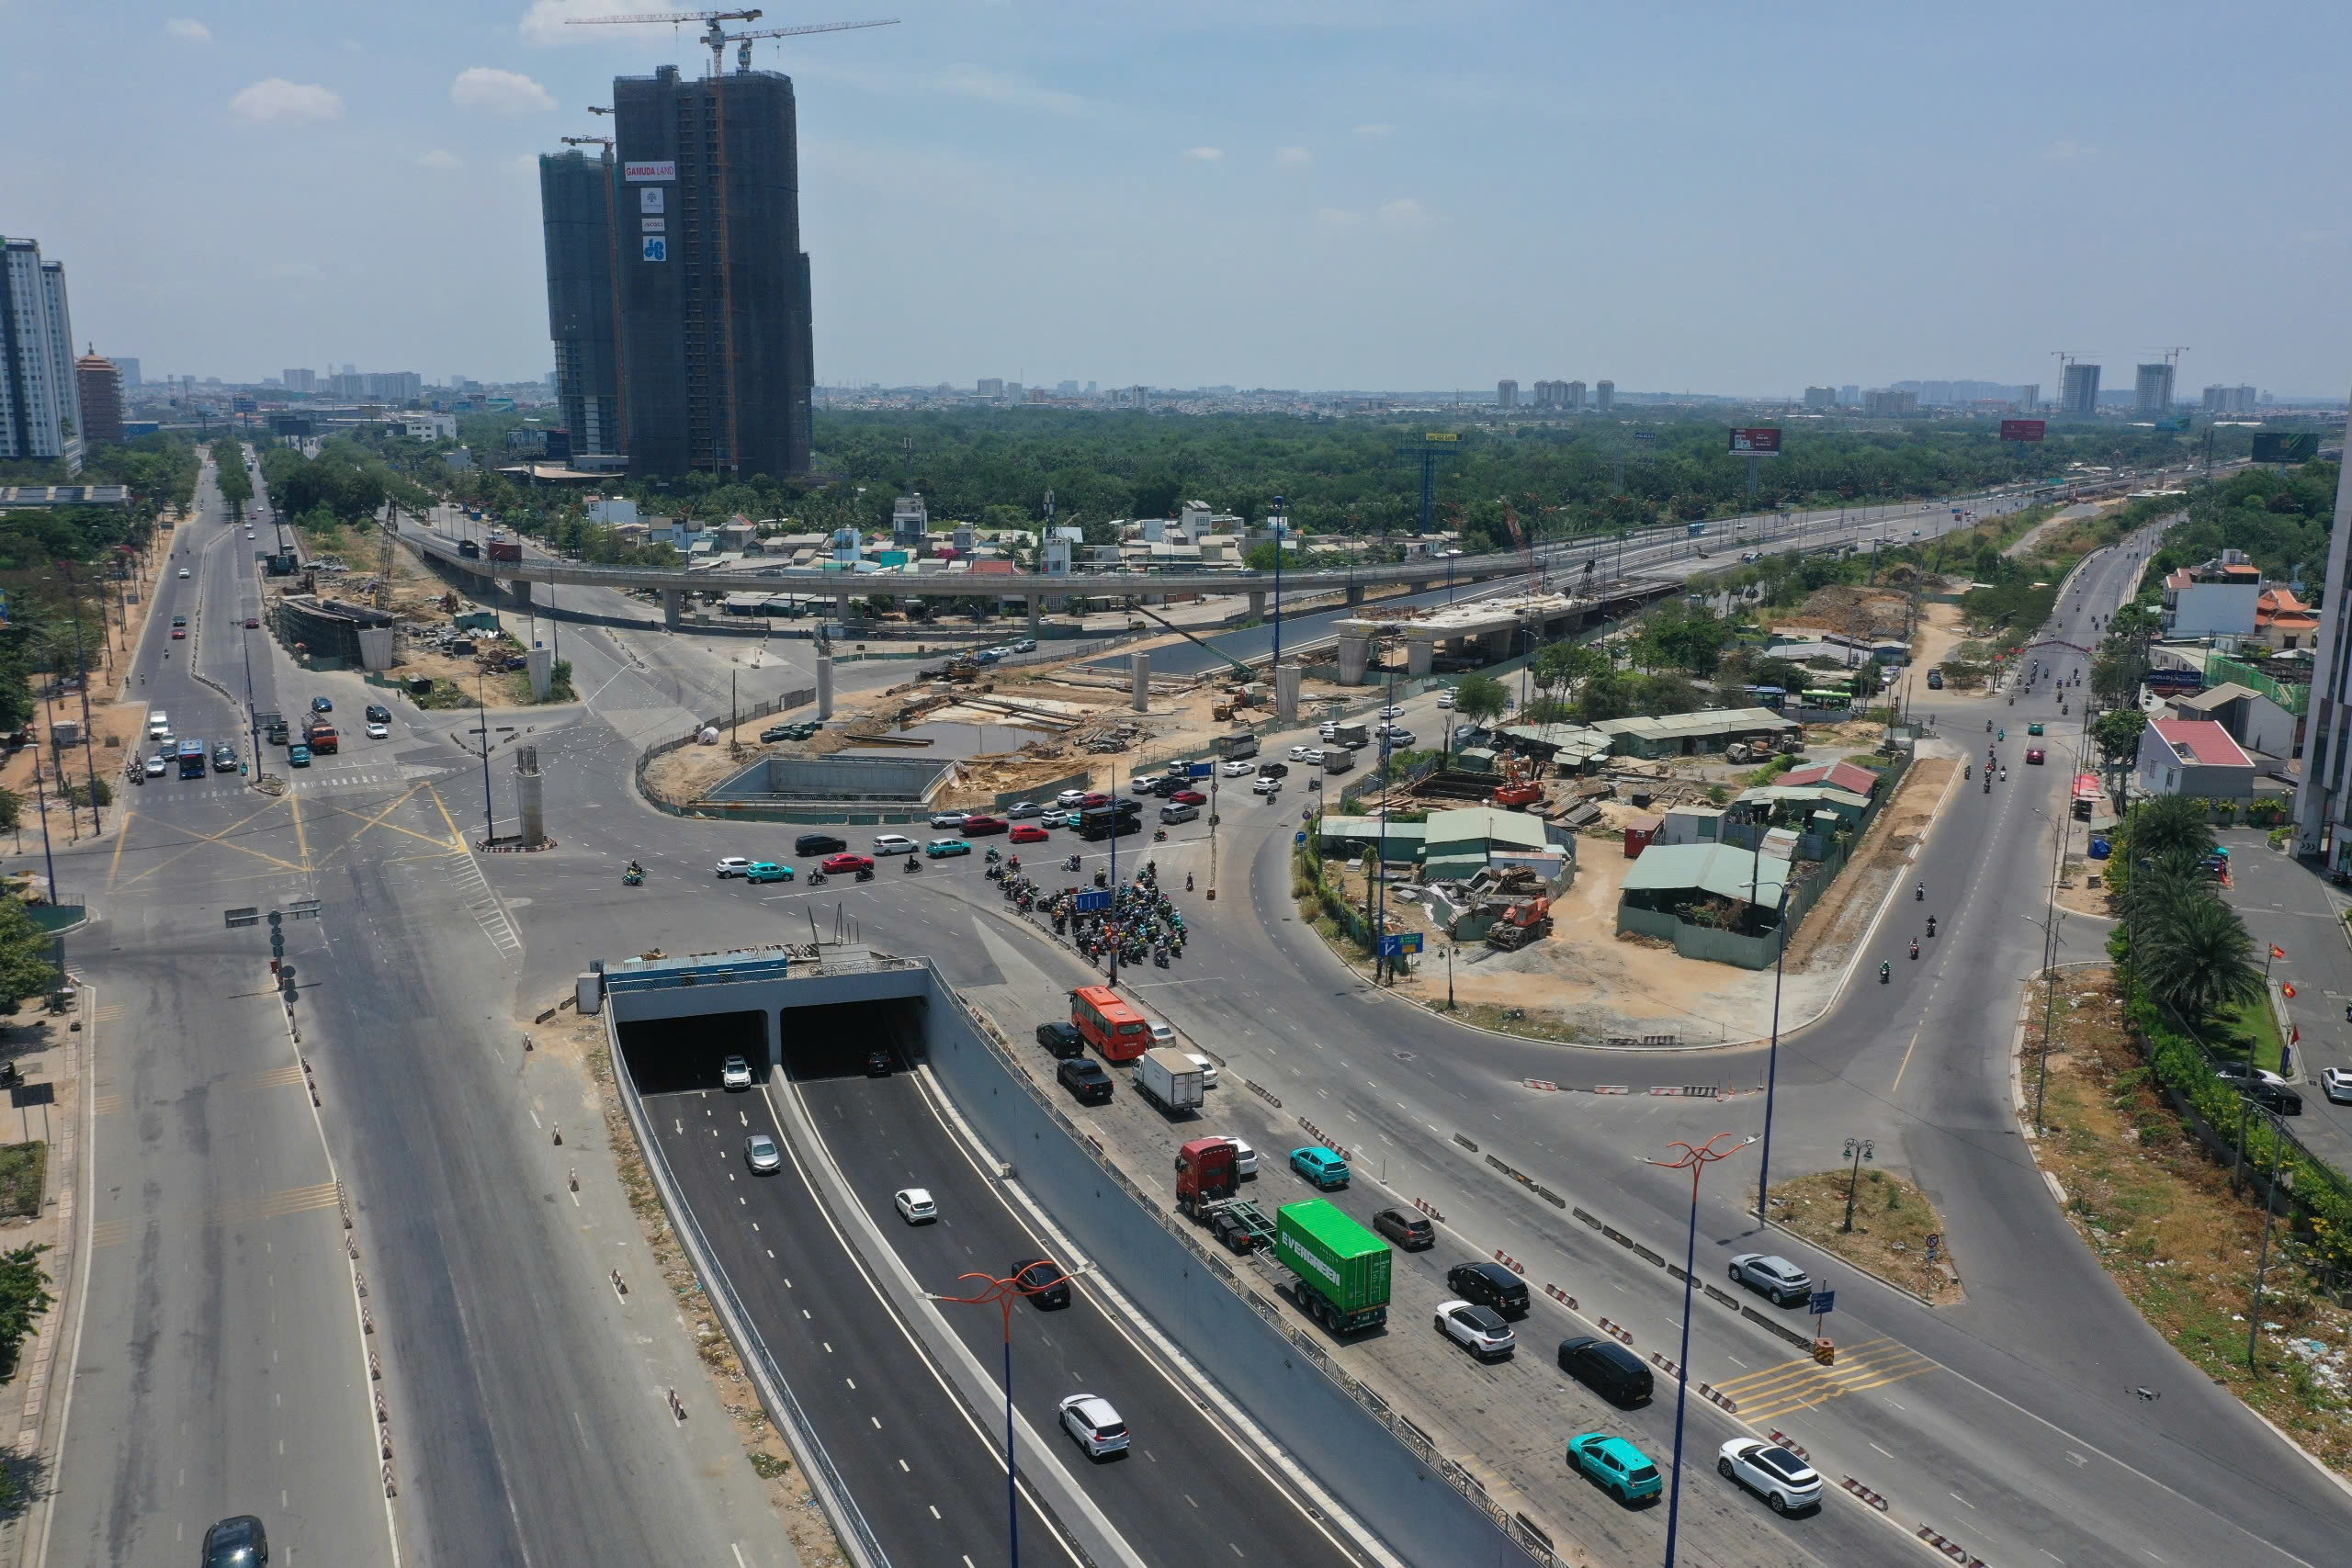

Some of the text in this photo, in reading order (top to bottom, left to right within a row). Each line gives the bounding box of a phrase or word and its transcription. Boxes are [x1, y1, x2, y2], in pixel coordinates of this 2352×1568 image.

[626, 166, 673, 175] GAMUDA LAND
[1283, 1230, 1340, 1286] EVERGREEN
